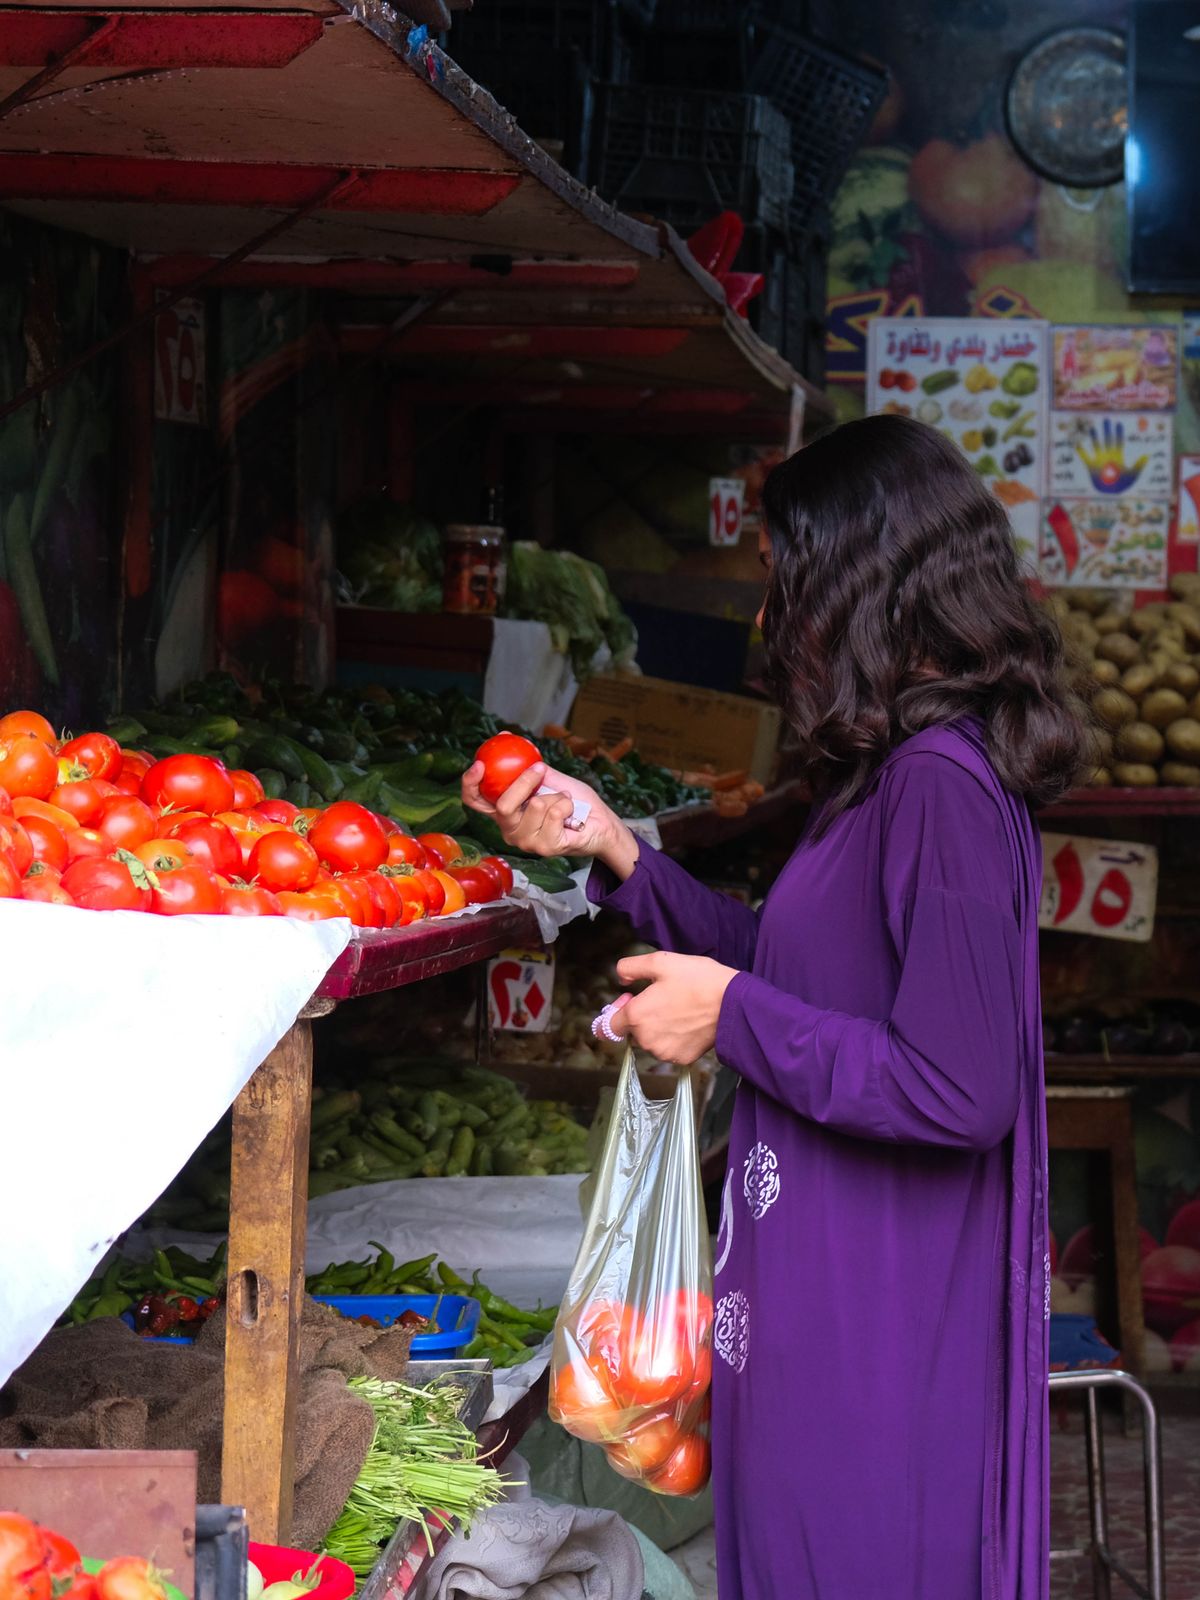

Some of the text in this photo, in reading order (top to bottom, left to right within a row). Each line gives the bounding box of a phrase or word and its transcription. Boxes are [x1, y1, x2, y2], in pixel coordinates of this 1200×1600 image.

[990, 334, 1036, 362] خضار
[1052, 840, 1133, 928] ١٥
[491, 960, 546, 1028] ٢٠
